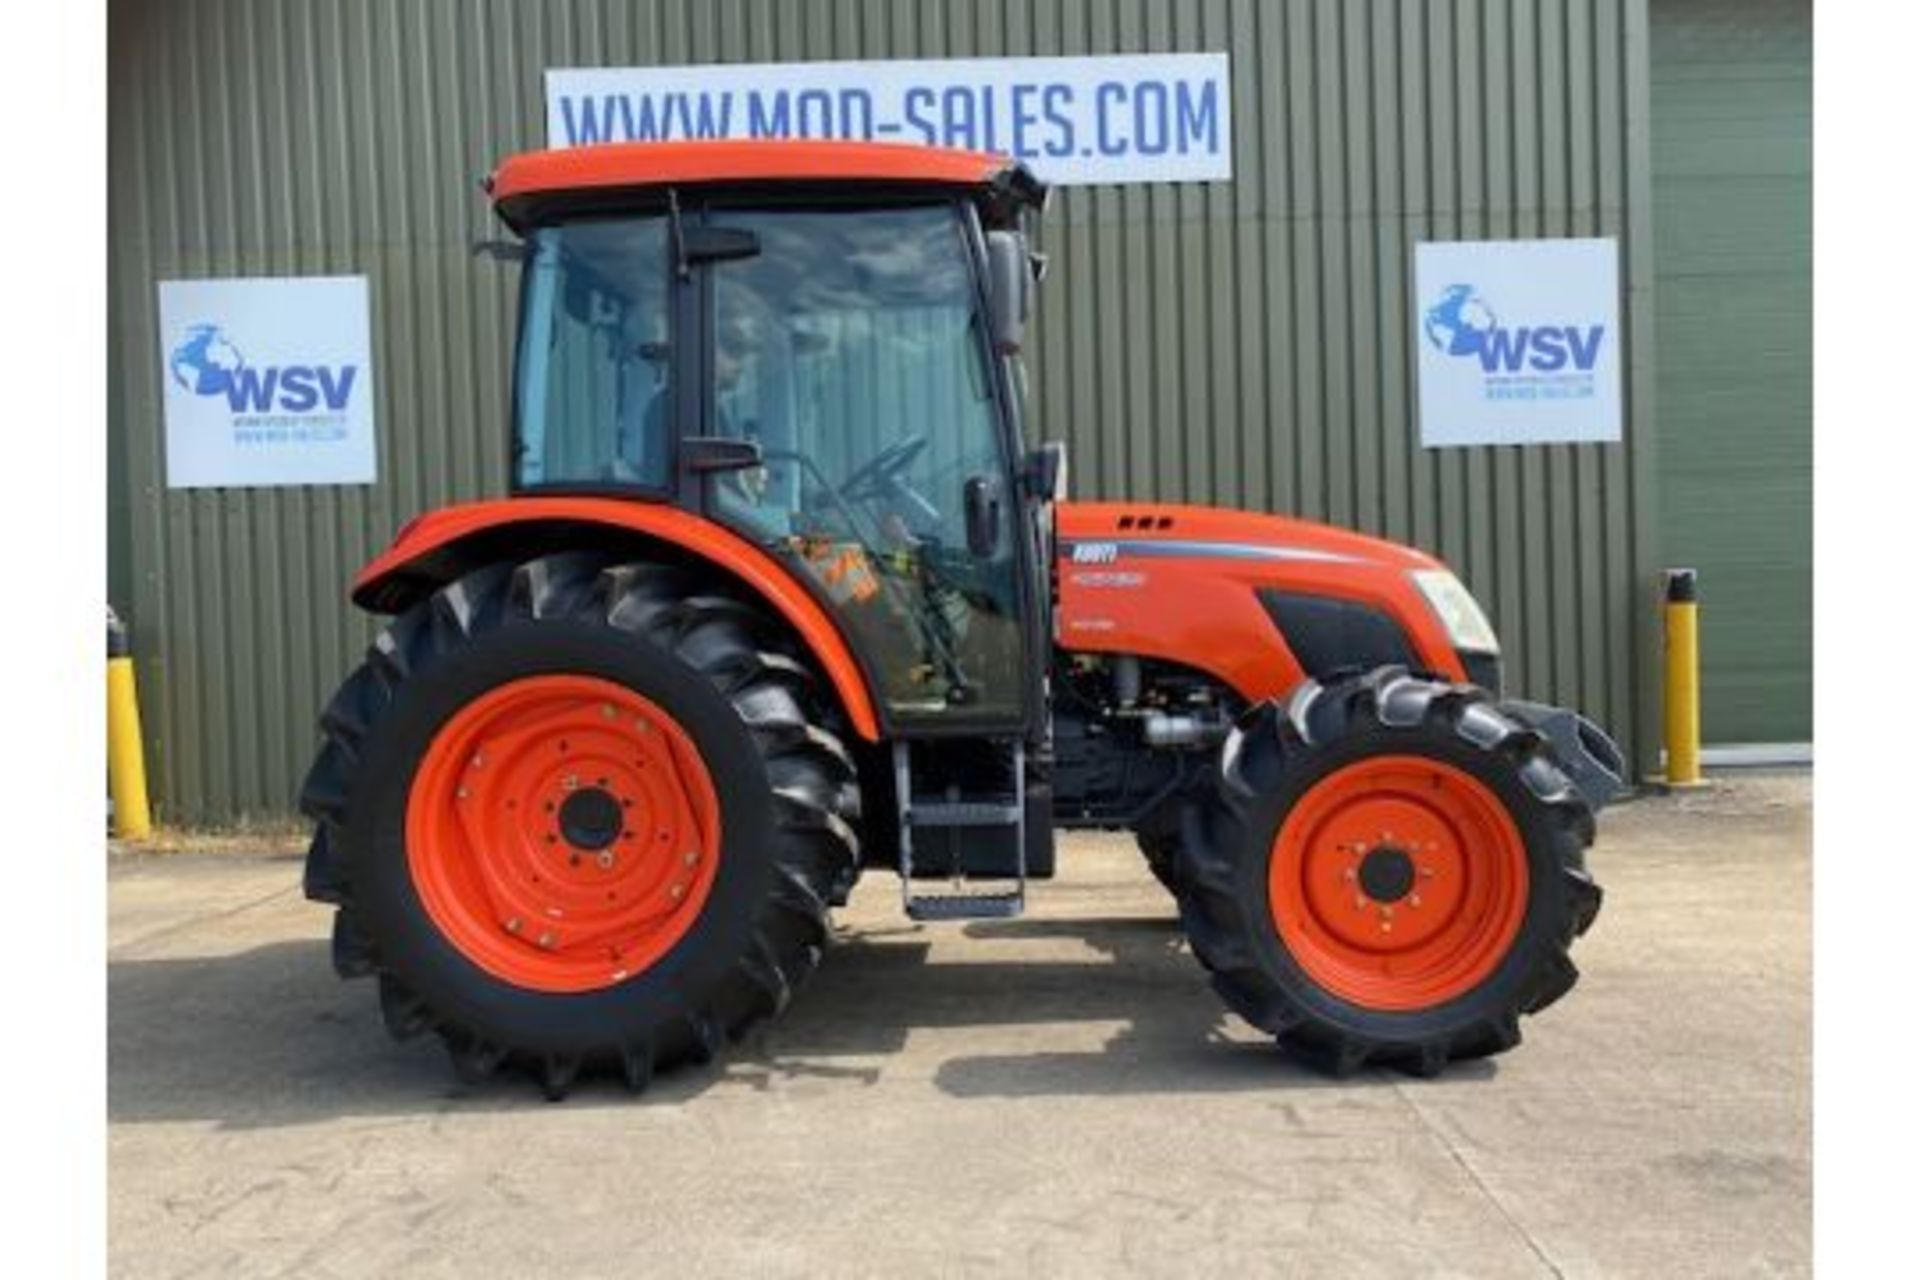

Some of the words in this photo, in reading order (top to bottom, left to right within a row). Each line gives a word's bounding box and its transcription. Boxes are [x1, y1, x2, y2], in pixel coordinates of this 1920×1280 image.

[560, 79, 1219, 158] WWWMOD-SALES.COM
[1477, 325, 1604, 373] WSV
[223, 365, 357, 413] WSV
